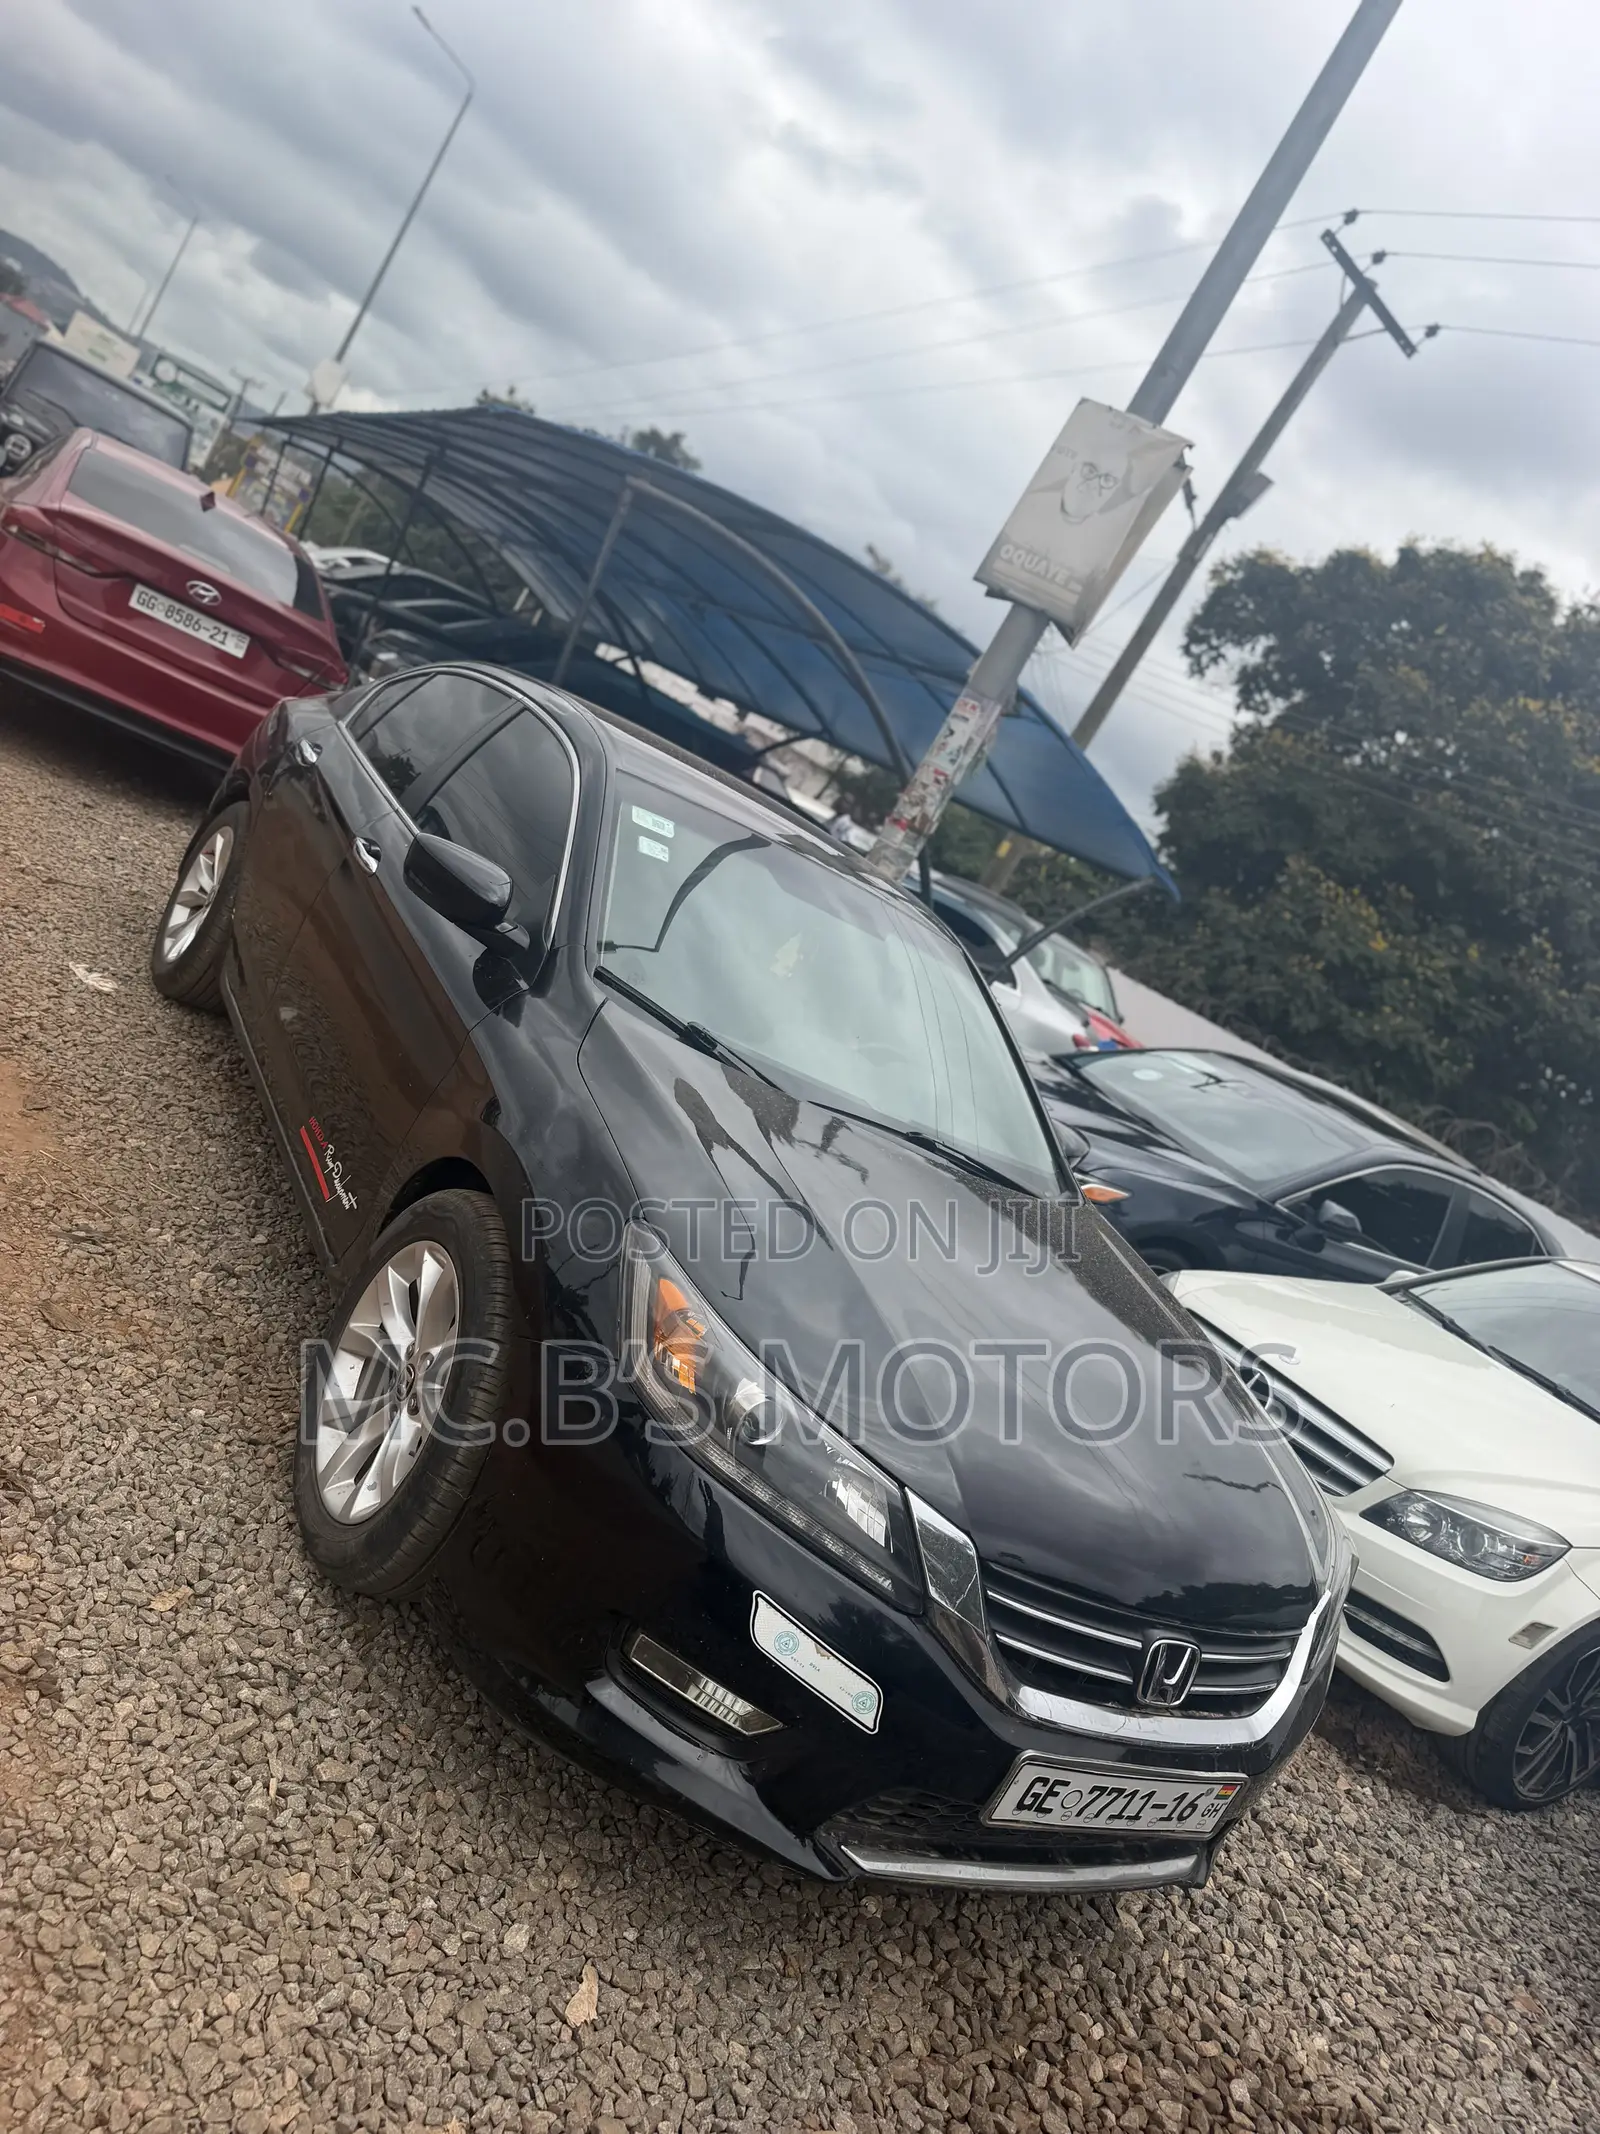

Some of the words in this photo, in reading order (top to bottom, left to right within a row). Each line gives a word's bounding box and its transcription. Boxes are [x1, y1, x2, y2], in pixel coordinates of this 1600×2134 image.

[1000, 543, 1071, 587] OQUAYE
[136, 590, 158, 611] GG
[164, 603, 229, 646] 8586-21
[1015, 1775, 1072, 1815] GE
[1074, 1784, 1205, 1822] 7711-16
[1200, 1802, 1224, 1819] GH
